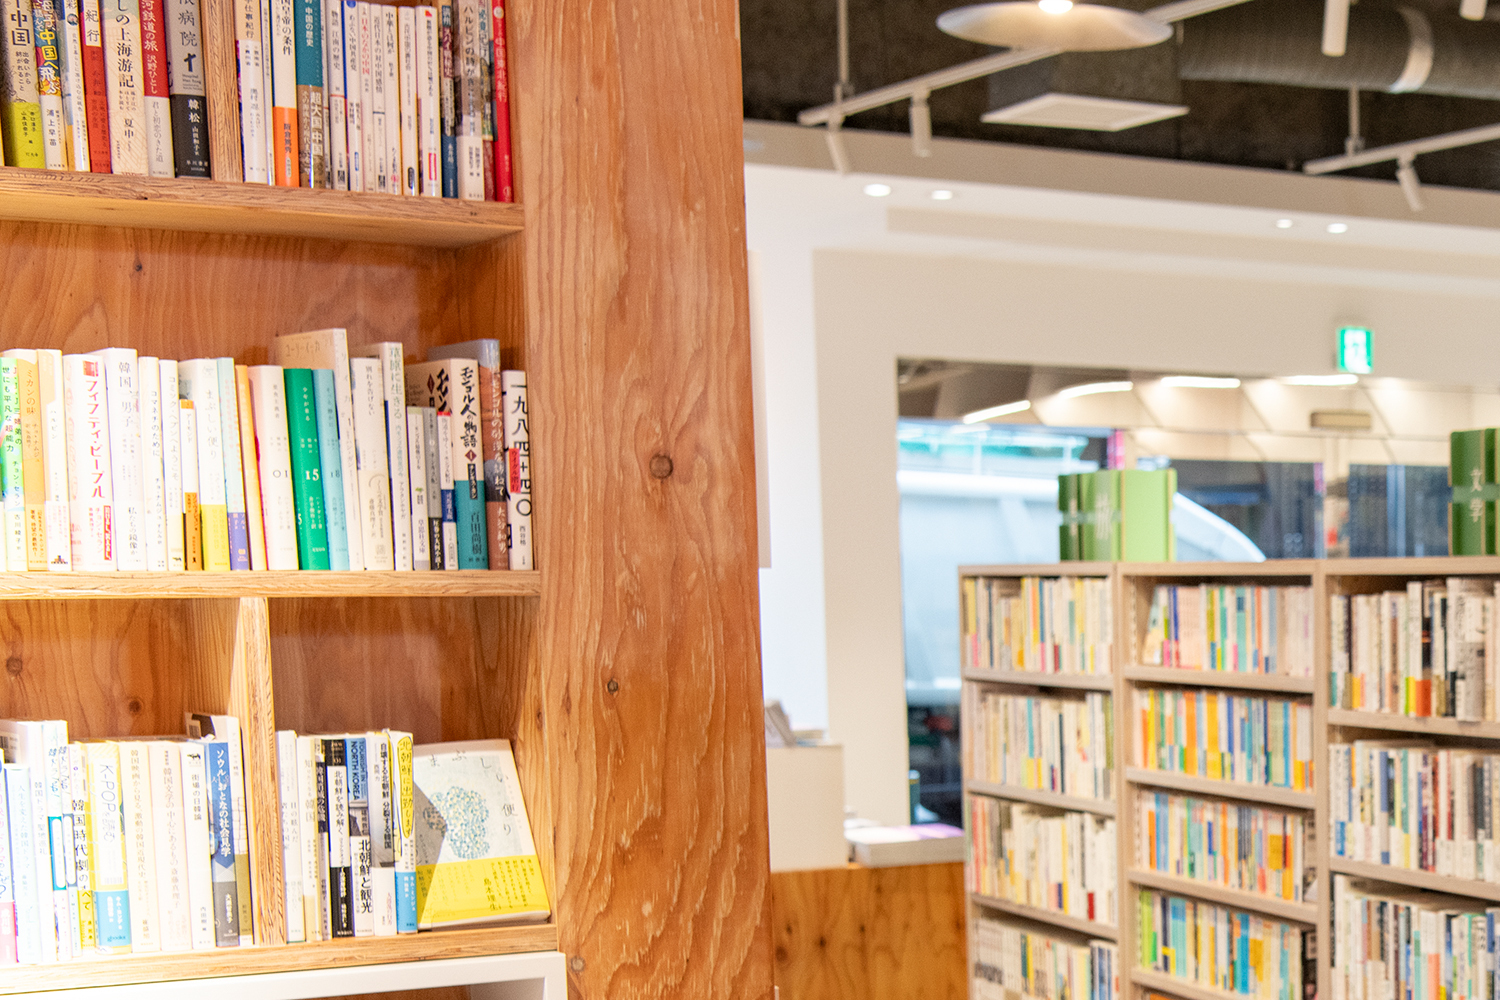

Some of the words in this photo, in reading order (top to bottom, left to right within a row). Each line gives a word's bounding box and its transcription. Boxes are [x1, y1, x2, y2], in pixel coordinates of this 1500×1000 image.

[26, 370, 36, 415] ミカンの味
[460, 366, 478, 448] モンゴル人の物語
[86, 380, 105, 498] フィフティ・ピープル
[305, 471, 319, 481] 15
[1470, 466, 1484, 523] 文学
